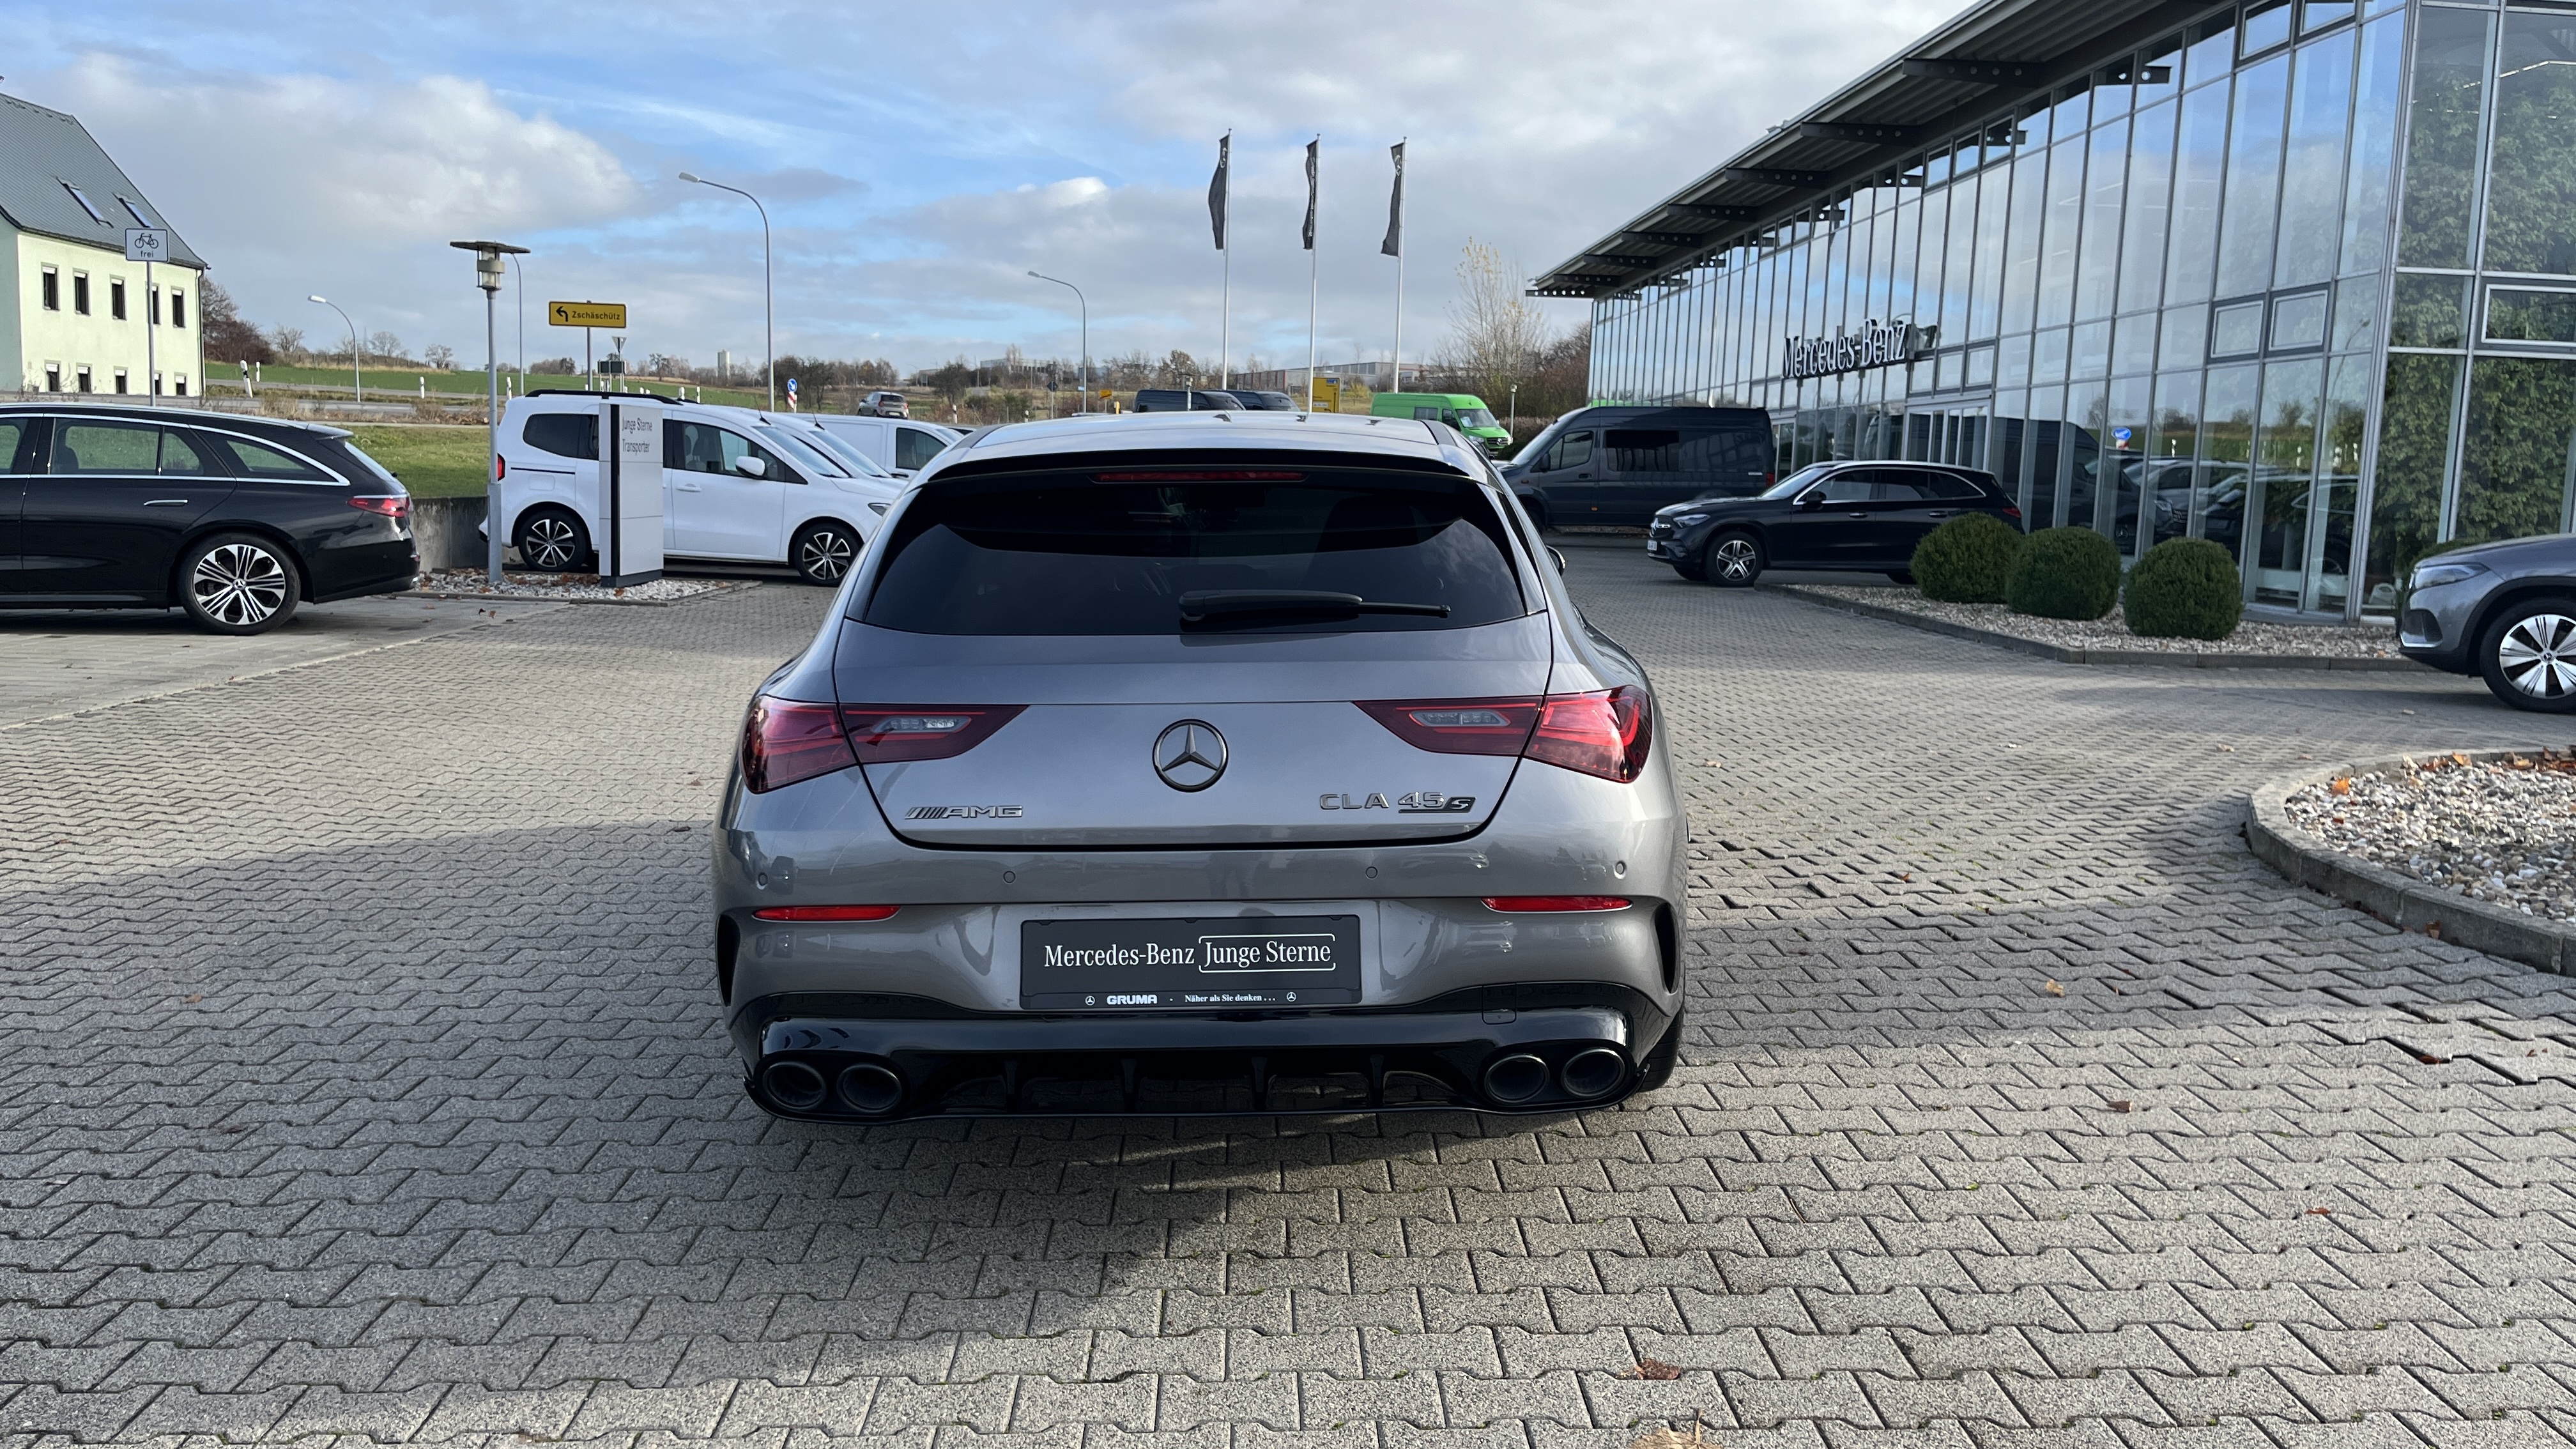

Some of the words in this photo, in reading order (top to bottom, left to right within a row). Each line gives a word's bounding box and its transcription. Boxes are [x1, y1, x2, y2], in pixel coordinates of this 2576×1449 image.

[141, 250, 154, 258] frei
[572, 310, 620, 320] Zschäschütz
[1783, 318, 1907, 378] Mercedes-Benz
[622, 416, 636, 434] Junge
[637, 417, 653, 432] Sterne
[622, 438, 650, 456] Transporter
[1320, 793, 1389, 810] CLA
[942, 805, 1023, 819] AMG
[1043, 942, 1195, 967] Mercedes-Benz
[1204, 941, 1261, 968] Junge
[1266, 940, 1331, 963] Sterne
[1107, 994, 1158, 1005] GRUMA
